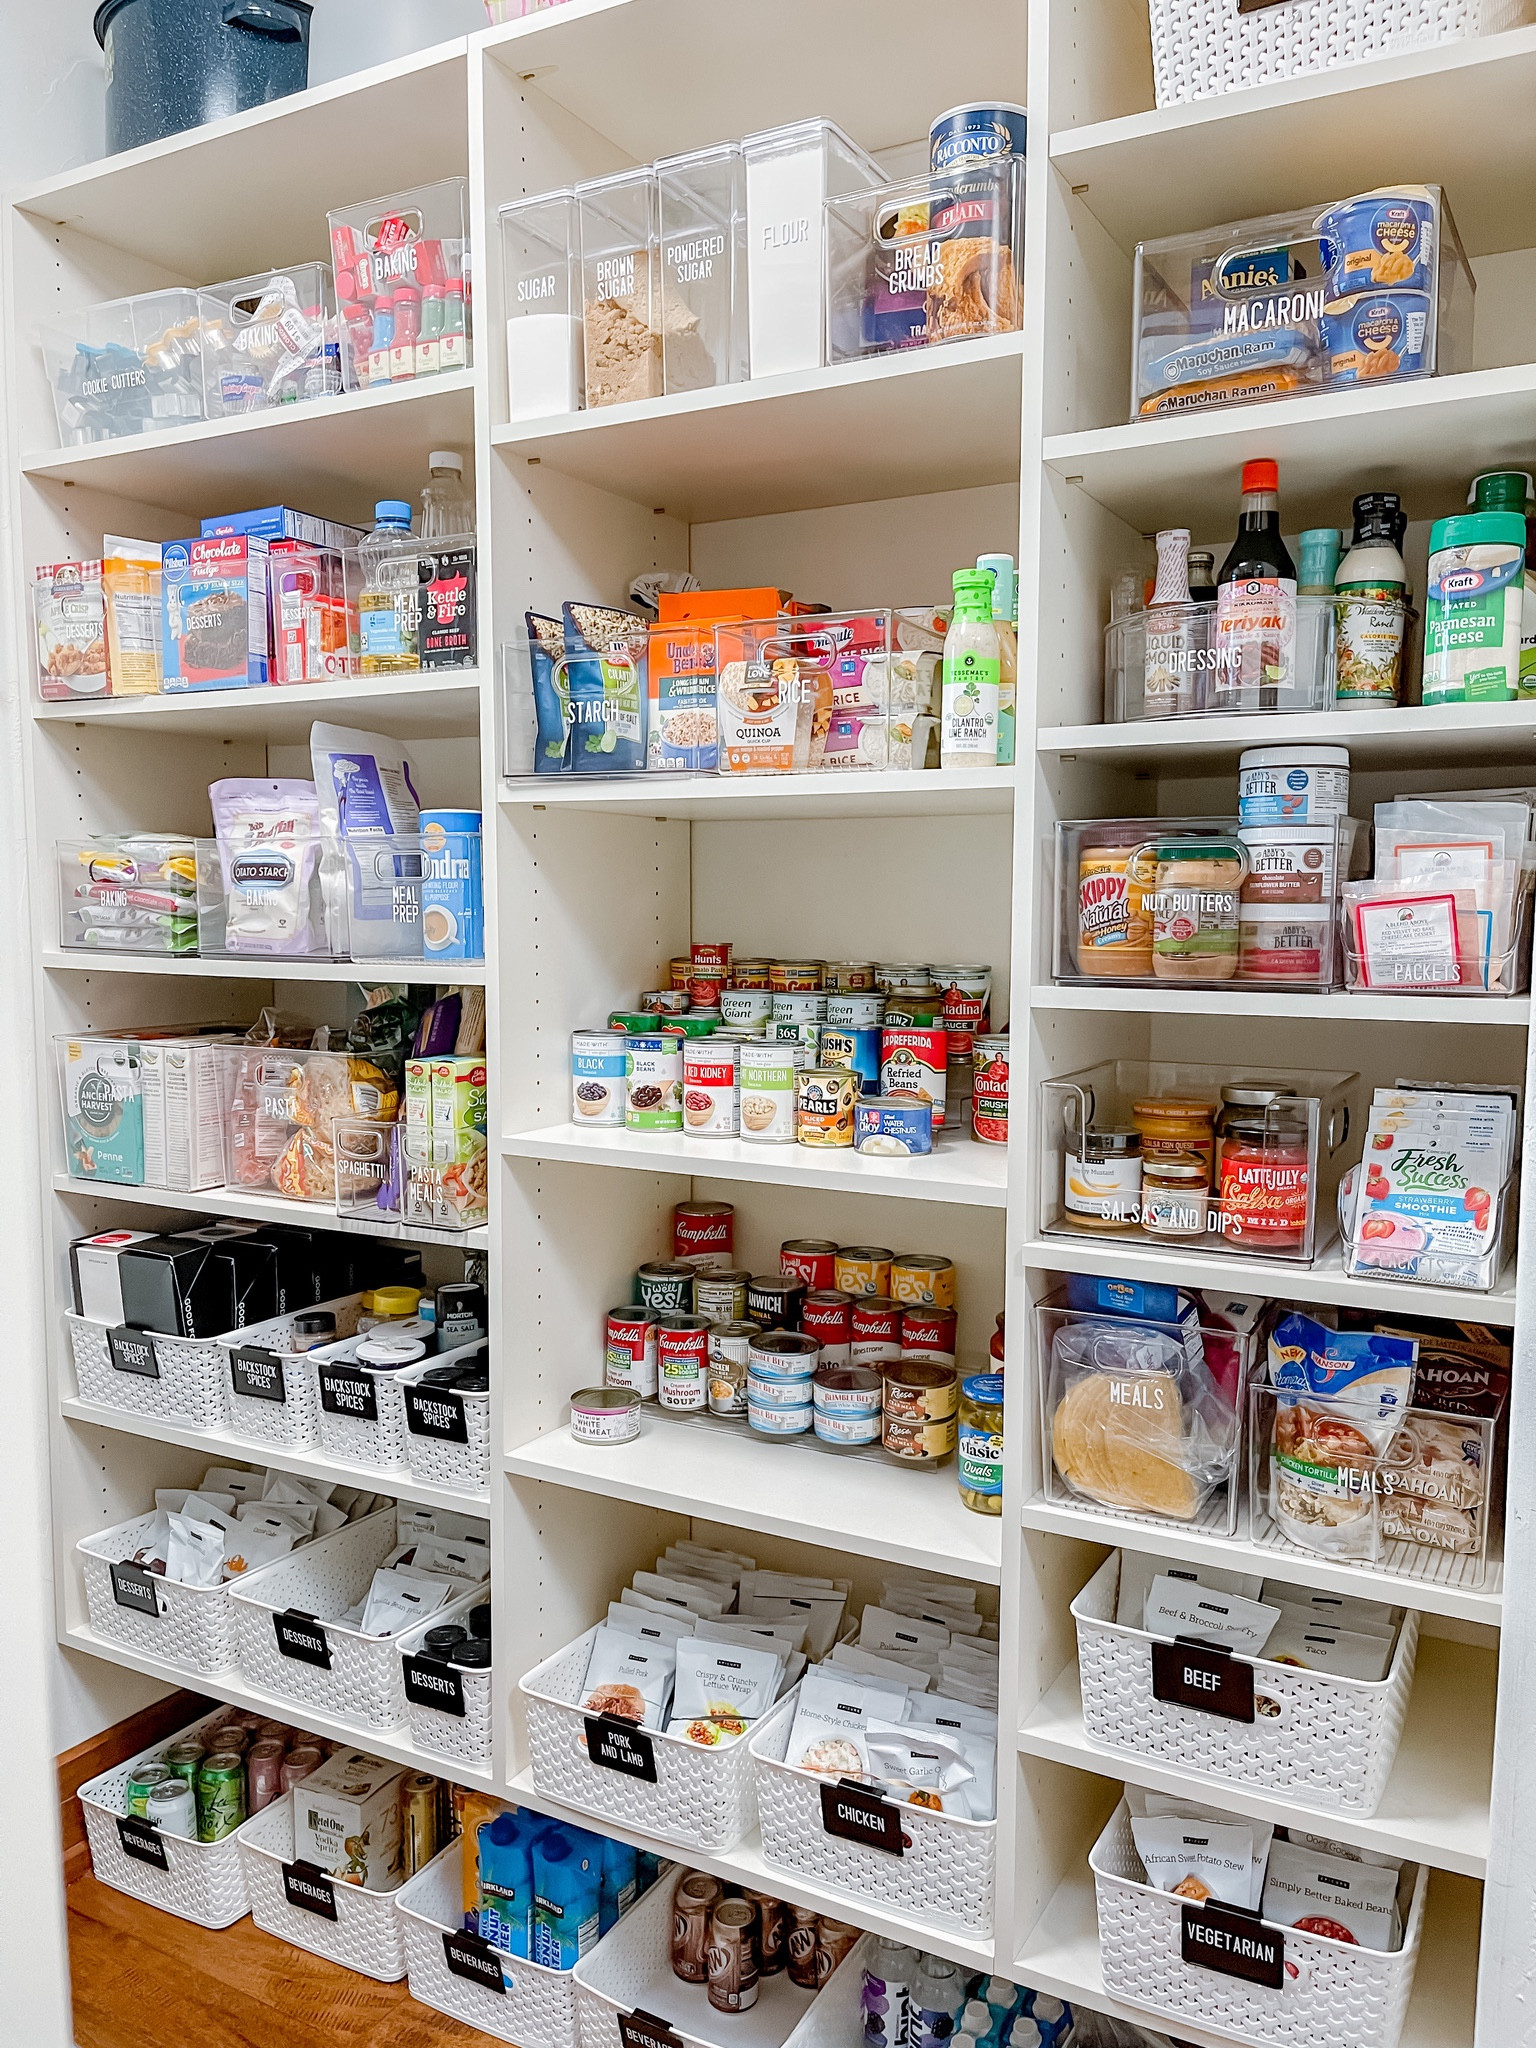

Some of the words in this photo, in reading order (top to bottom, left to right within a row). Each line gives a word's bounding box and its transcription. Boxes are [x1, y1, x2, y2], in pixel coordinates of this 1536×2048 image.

[963, 124, 981, 132] 1973
[936, 136, 999, 165] RACCONTO
[942, 203, 986, 226] PLAIN
[1391, 209, 1405, 217] Kraft
[763, 219, 808, 250] FLOUR
[667, 235, 725, 265] POWDERED
[895, 241, 942, 272] BREAD
[375, 248, 418, 280] BAKING
[597, 255, 635, 282] BROWN
[1346, 253, 1372, 267] original
[677, 259, 712, 284] SUGAR
[889, 264, 945, 295] CRUMBS
[517, 276, 555, 302] SUGAR
[598, 275, 635, 301] SUGAR
[1223, 289, 1325, 335] MACARONI
[240, 325, 278, 350] BAKING
[1175, 346, 1240, 372] Maruchan
[1332, 354, 1356, 367] original
[1197, 367, 1213, 376] Soy
[1214, 361, 1239, 371] Sauce
[82, 376, 109, 395] COOKIE
[111, 370, 146, 390] CUTTERS
[1167, 390, 1227, 410] Maruchan
[1231, 382, 1276, 397] Ramen
[193, 541, 241, 561] Chocolate
[165, 556, 188, 568] Pillsbury
[1447, 577, 1473, 589] Kraft
[394, 592, 422, 612] MEAL
[427, 589, 467, 605] Kettle
[1441, 601, 1477, 611] GRATED
[426, 607, 436, 619] &
[438, 603, 466, 619] Fire
[66, 622, 104, 639] DESSERTS
[186, 613, 222, 631] DESSERTS
[394, 612, 423, 632] PREP
[1220, 614, 1287, 633] Teriyaki
[1369, 616, 1395, 629] Ranch
[1429, 614, 1496, 635] Parmesan
[425, 637, 443, 648] BONE
[445, 634, 467, 647] BROTH
[1434, 630, 1484, 646] Cheese
[1169, 646, 1242, 674] DRESSING
[778, 679, 811, 704] RICE
[833, 692, 861, 706] RICE
[567, 700, 619, 724] STARCH
[625, 714, 637, 726] SALT
[951, 717, 984, 728] CILANTRO
[736, 727, 782, 739] QUINOA
[963, 728, 987, 738] RANCH
[1245, 781, 1277, 795] BETTER
[1255, 857, 1293, 872] BETTER
[100, 889, 128, 907] BAKING
[246, 889, 279, 907] BAKING
[392, 886, 419, 905] MEAL
[1141, 893, 1165, 912] NUT
[1173, 893, 1233, 912] BUTTERS
[392, 905, 419, 924] PREP
[1082, 897, 1130, 930] Natural
[1100, 921, 1128, 937] Honey
[1097, 933, 1121, 945] Creamy
[1273, 935, 1313, 949] BETTER
[1394, 963, 1461, 982] PACKETS
[722, 998, 752, 1008] Green
[724, 1007, 752, 1018] Giant
[777, 1028, 797, 1039] 365
[889, 1034, 932, 1049] PREFERIDA
[577, 1057, 605, 1070] BLACK
[688, 1067, 698, 1078] RED
[700, 1067, 727, 1079] KIDNEY
[748, 1069, 787, 1082] NORTHERN
[887, 1067, 922, 1079] Refried
[889, 1078, 919, 1089] Beans
[81, 1100, 113, 1112] HARVEST
[264, 1097, 299, 1116] PASTA
[799, 1097, 837, 1114] PEARLS
[804, 1115, 825, 1123] SLICED
[859, 1110, 869, 1123] LA
[883, 1119, 904, 1127] WATER
[859, 1119, 880, 1134] CHOY
[883, 1126, 917, 1135] CHESTNUTS
[1161, 1140, 1175, 1149] CON
[1175, 1141, 1195, 1150] QUESO
[97, 1150, 123, 1163] Penne
[1391, 1148, 1465, 1173] Fresh
[338, 1159, 385, 1179] SPAGHETTI
[411, 1165, 442, 1186] PASTA
[1396, 1164, 1469, 1192] Success
[1268, 1169, 1300, 1191] JULY
[409, 1182, 443, 1204] MEALS
[1398, 1195, 1455, 1206] STRAWBERRY
[1394, 1202, 1457, 1215] SMOOTHIE
[1101, 1200, 1159, 1226] SALSAS
[1168, 1206, 1199, 1230] AND
[1208, 1209, 1243, 1236] DIPS
[1246, 1217, 1289, 1227] MILD
[676, 1221, 728, 1243] Campbell's
[641, 1282, 683, 1309] Yes!
[184, 1298, 194, 1327] GOOD
[446, 1325, 459, 1333] SEA
[460, 1324, 475, 1332] SALT
[113, 1338, 150, 1358] BACKSTOCK
[659, 1334, 706, 1352] Campbell's
[123, 1350, 146, 1366] SPICES
[237, 1358, 276, 1379] BACKSTOCK
[247, 1373, 271, 1389] SPICES
[324, 1377, 371, 1398] BACKSTOCK
[662, 1386, 701, 1397] Mushroom
[666, 1396, 696, 1405] SOUP
[1110, 1381, 1164, 1410] MEALS
[335, 1393, 364, 1411] SPICES
[413, 1397, 458, 1420] BACKSTOCK
[423, 1412, 450, 1429] SPICES
[577, 1419, 600, 1429] WHITE
[589, 1428, 612, 1436] MEAT
[961, 1441, 1000, 1461] Vlasic
[964, 1460, 993, 1477] Ovals
[1337, 1465, 1394, 1496] MEALS
[117, 1577, 152, 1600] DESSERTS
[1158, 1606, 1177, 1621] Beef
[1178, 1612, 1187, 1621] &
[1188, 1614, 1224, 1631] Broccoli
[282, 1627, 323, 1652] DESSERTS
[618, 1666, 635, 1675] Pulled
[635, 1668, 648, 1678] Pork
[695, 1669, 718, 1681] Crispy
[719, 1673, 726, 1681] &
[727, 1675, 758, 1688] Crunchy
[1183, 1666, 1222, 1692] BEEF
[411, 1670, 456, 1696] DESSERTS
[703, 1679, 729, 1691] Lettuce
[731, 1683, 751, 1695] Wrap
[608, 1731, 632, 1750] PORK
[601, 1743, 618, 1760] AND
[620, 1749, 644, 1768] LAMB
[328, 1818, 345, 1832] One
[837, 1803, 885, 1833] CHICKEN
[123, 1830, 162, 1856] BEVERAGES
[314, 1832, 339, 1848] Vodka
[1144, 1853, 1177, 1864] African
[1196, 1853, 1222, 1867] Potato
[1223, 1858, 1245, 1871] Stew
[288, 1876, 332, 1904] BEVERAGES
[1269, 1876, 1302, 1895] Simply
[1304, 1887, 1332, 1903] Better
[1334, 1896, 1363, 1911] Baked
[1187, 1921, 1275, 1964] VEGETARIAN
[450, 1947, 500, 1978] BEVERAGES
